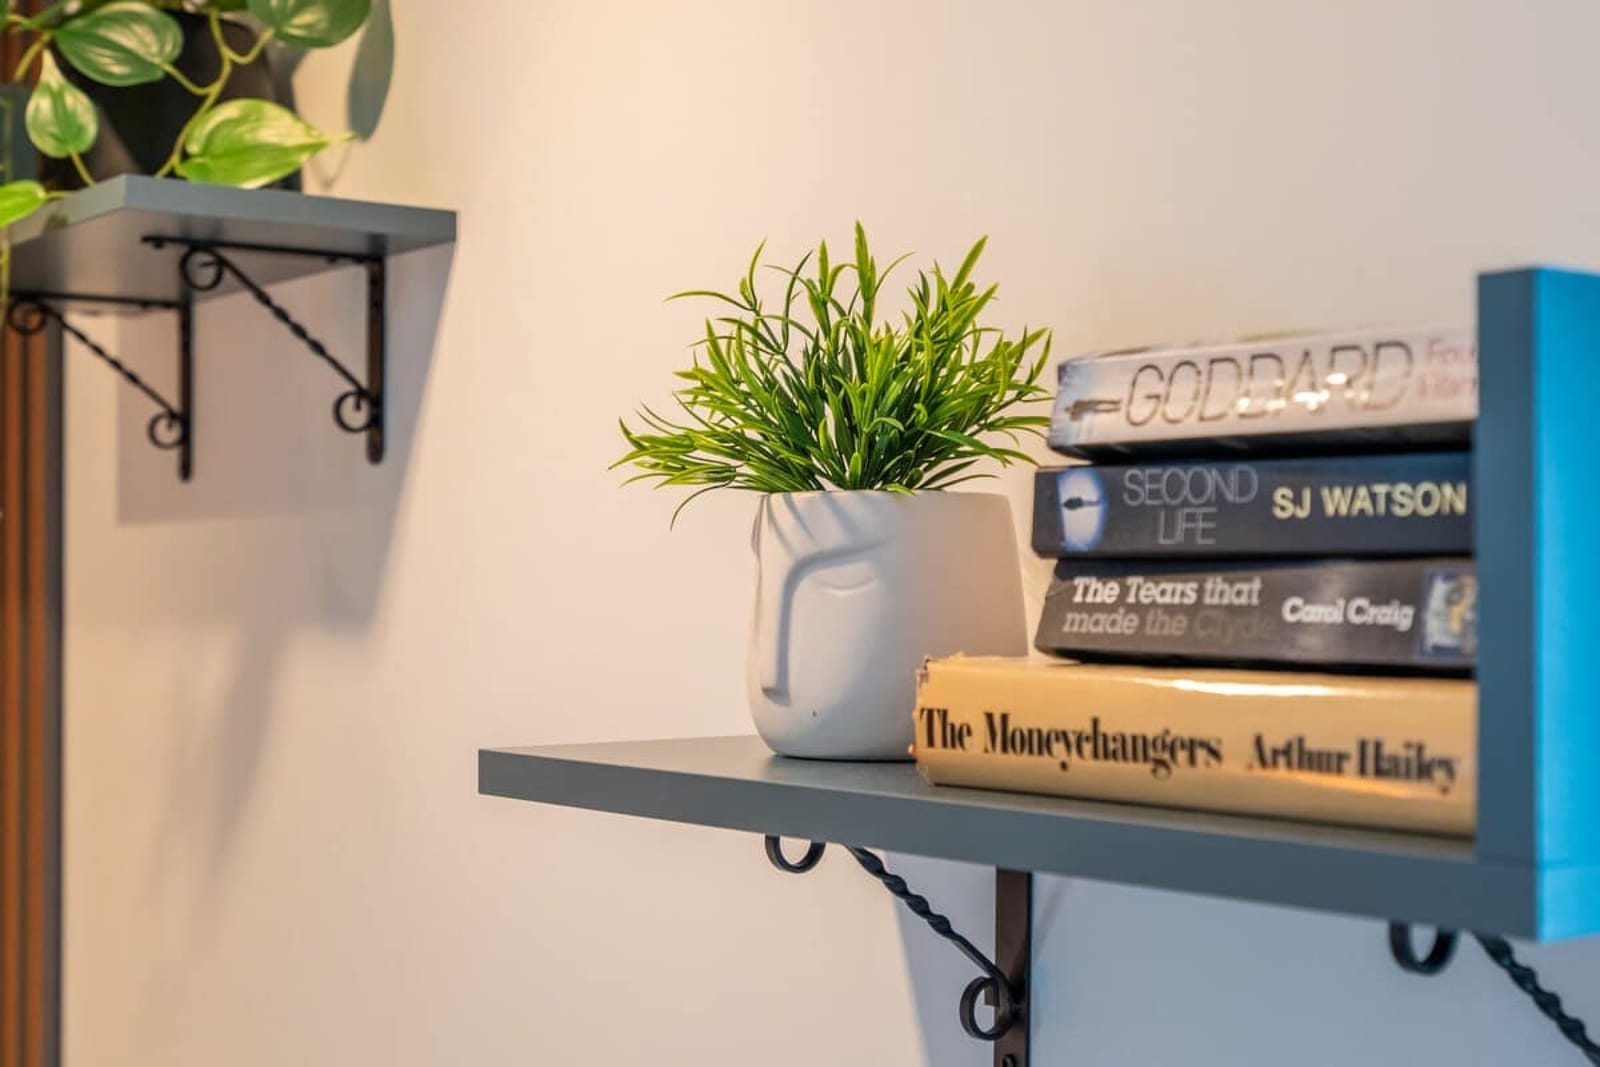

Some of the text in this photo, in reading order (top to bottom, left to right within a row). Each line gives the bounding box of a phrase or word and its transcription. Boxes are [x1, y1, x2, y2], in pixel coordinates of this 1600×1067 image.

[1125, 340, 1415, 426] GODDARD
[1122, 464, 1258, 507] SECOND
[1271, 481, 1468, 519] SJ WATSON
[1158, 507, 1217, 545] LIFE
[1072, 577, 1264, 606] The Tears that
[1063, 607, 1139, 635] made
[1144, 609, 1187, 636] the
[1281, 597, 1416, 632] Carol Craig
[918, 707, 1460, 796] The Moneychangers Arthur Hailey
